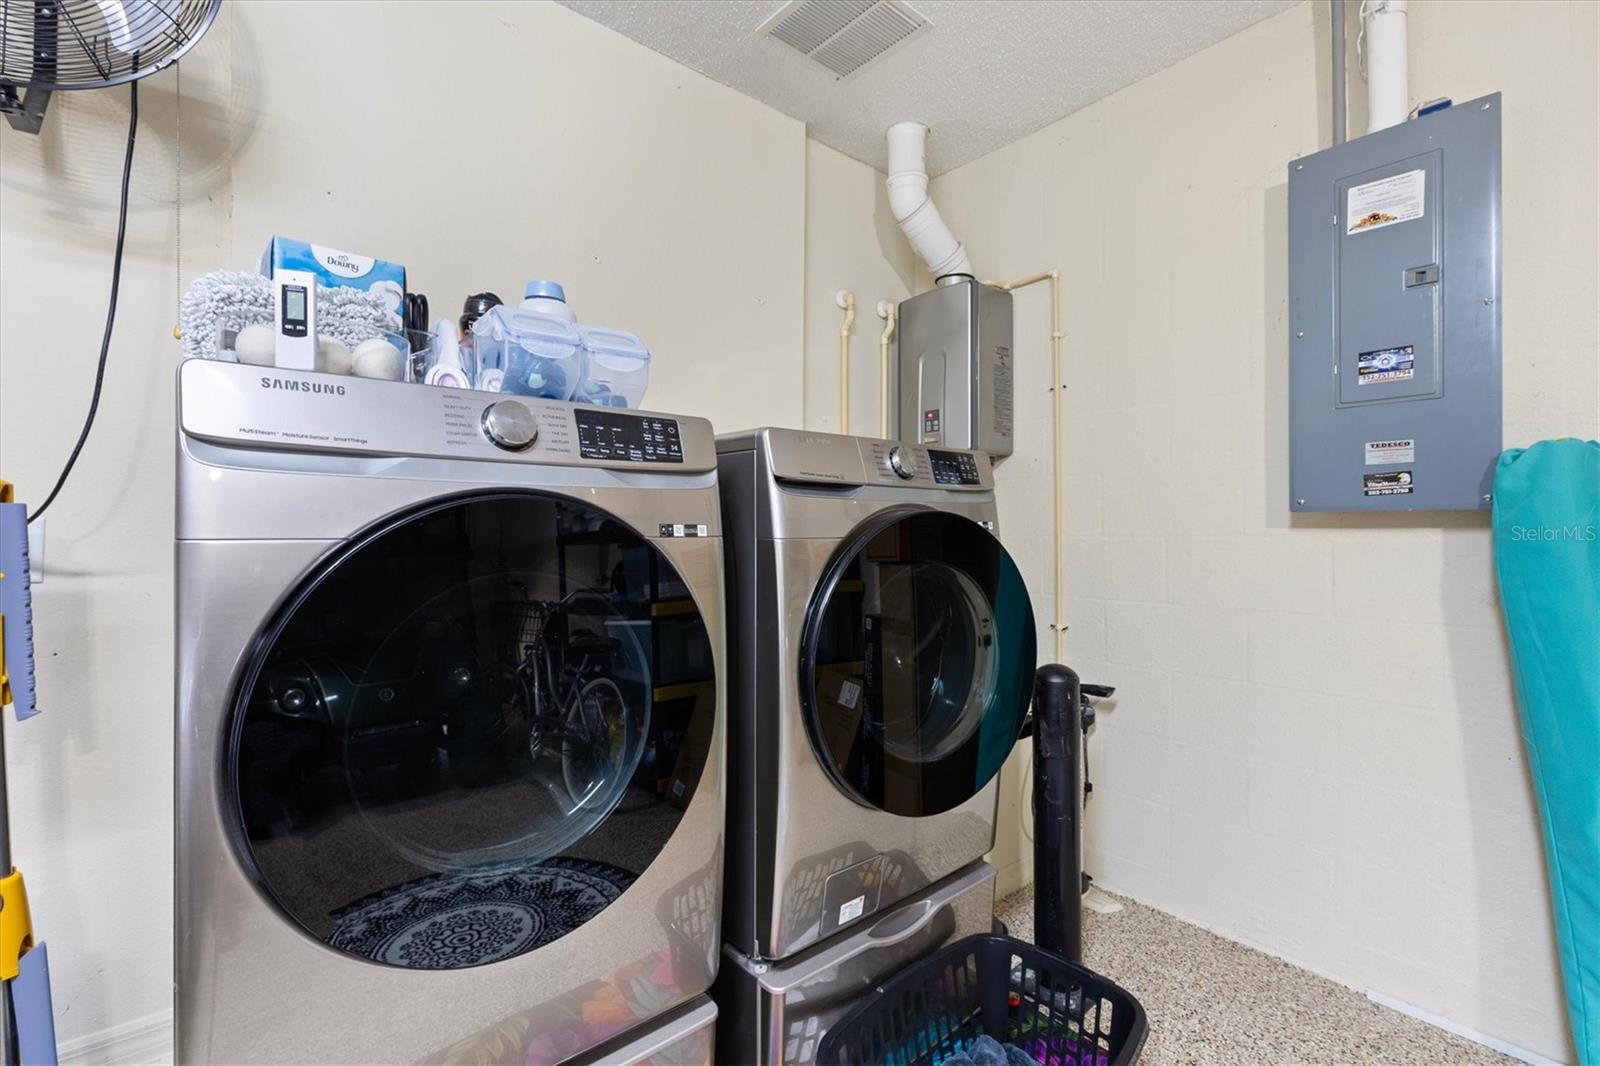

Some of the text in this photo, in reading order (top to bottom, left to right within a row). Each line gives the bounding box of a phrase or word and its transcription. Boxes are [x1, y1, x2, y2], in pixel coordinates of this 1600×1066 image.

[327, 256, 359, 273] Downy
[260, 377, 346, 396] SAMSUNG
[1370, 440, 1411, 449] TEDESCO
